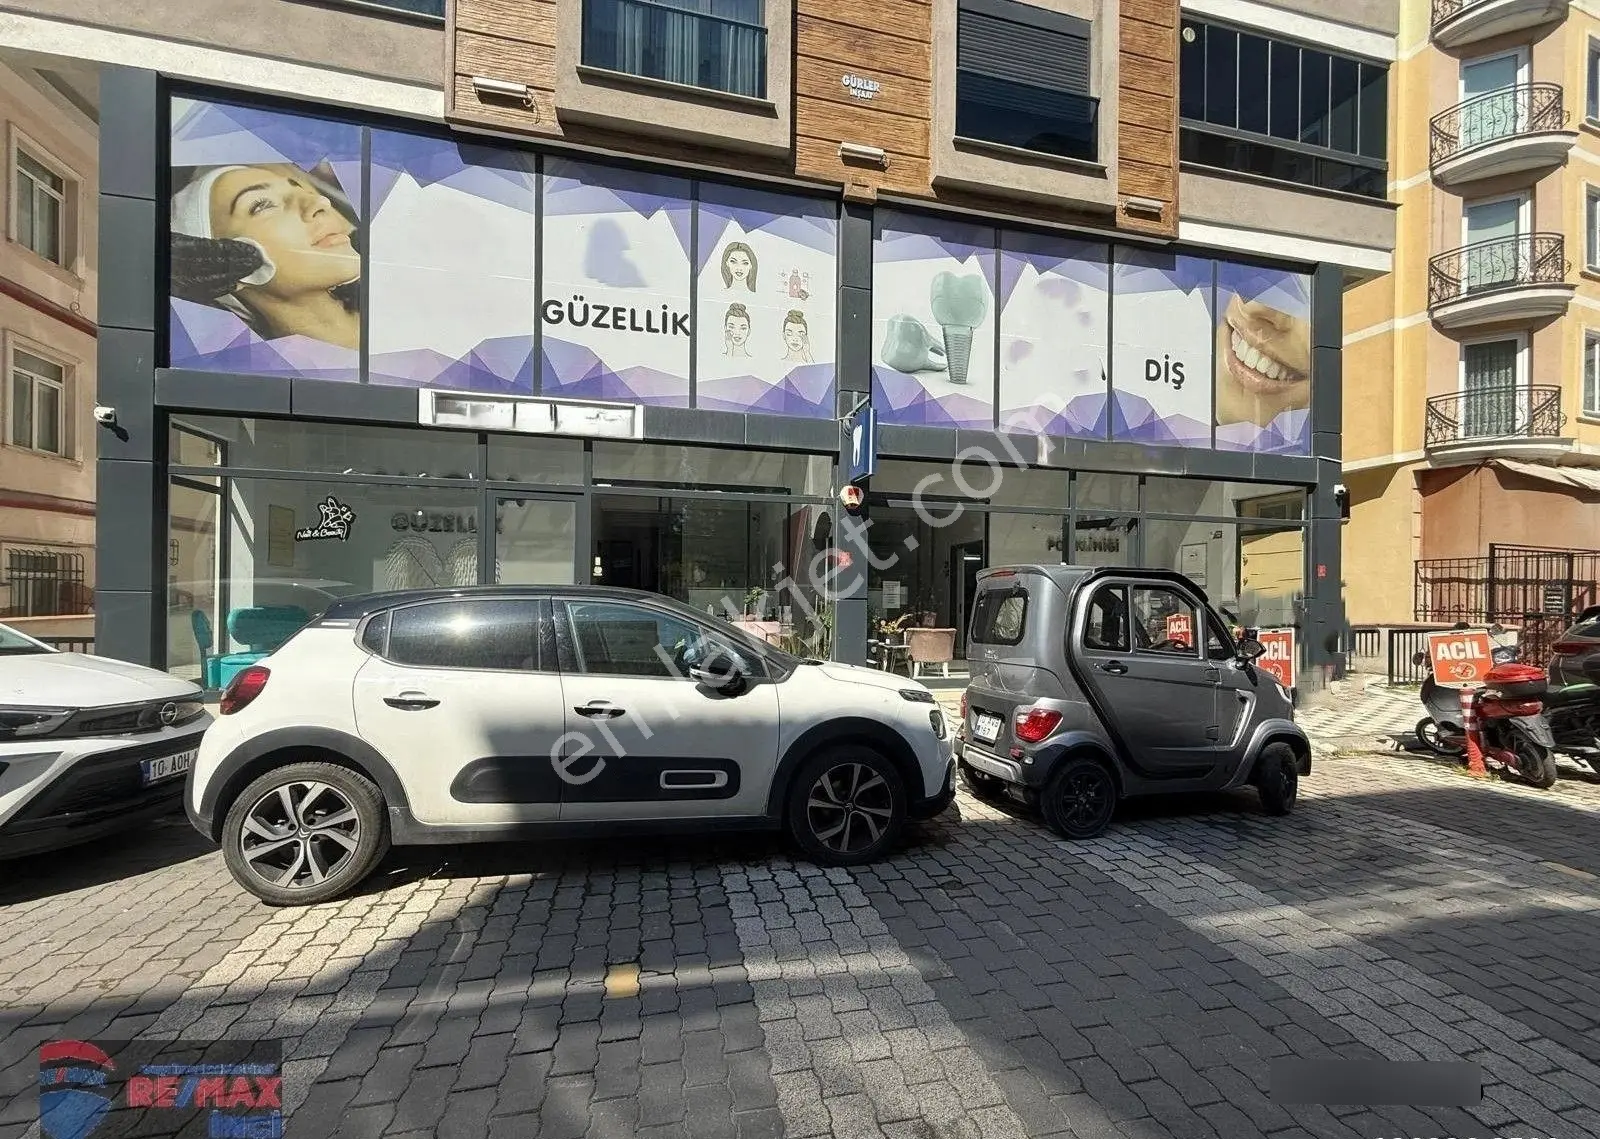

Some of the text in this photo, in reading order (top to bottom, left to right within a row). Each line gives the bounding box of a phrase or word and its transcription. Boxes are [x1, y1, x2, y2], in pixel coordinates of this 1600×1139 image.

[842, 74, 880, 92] GÜRLER
[541, 295, 690, 336] GÜZELLİK
[1145, 354, 1185, 390] DİŞ
[1170, 618, 1189, 634] ACİL
[1436, 637, 1487, 660] ACİL
[152, 760, 165, 777] 10
